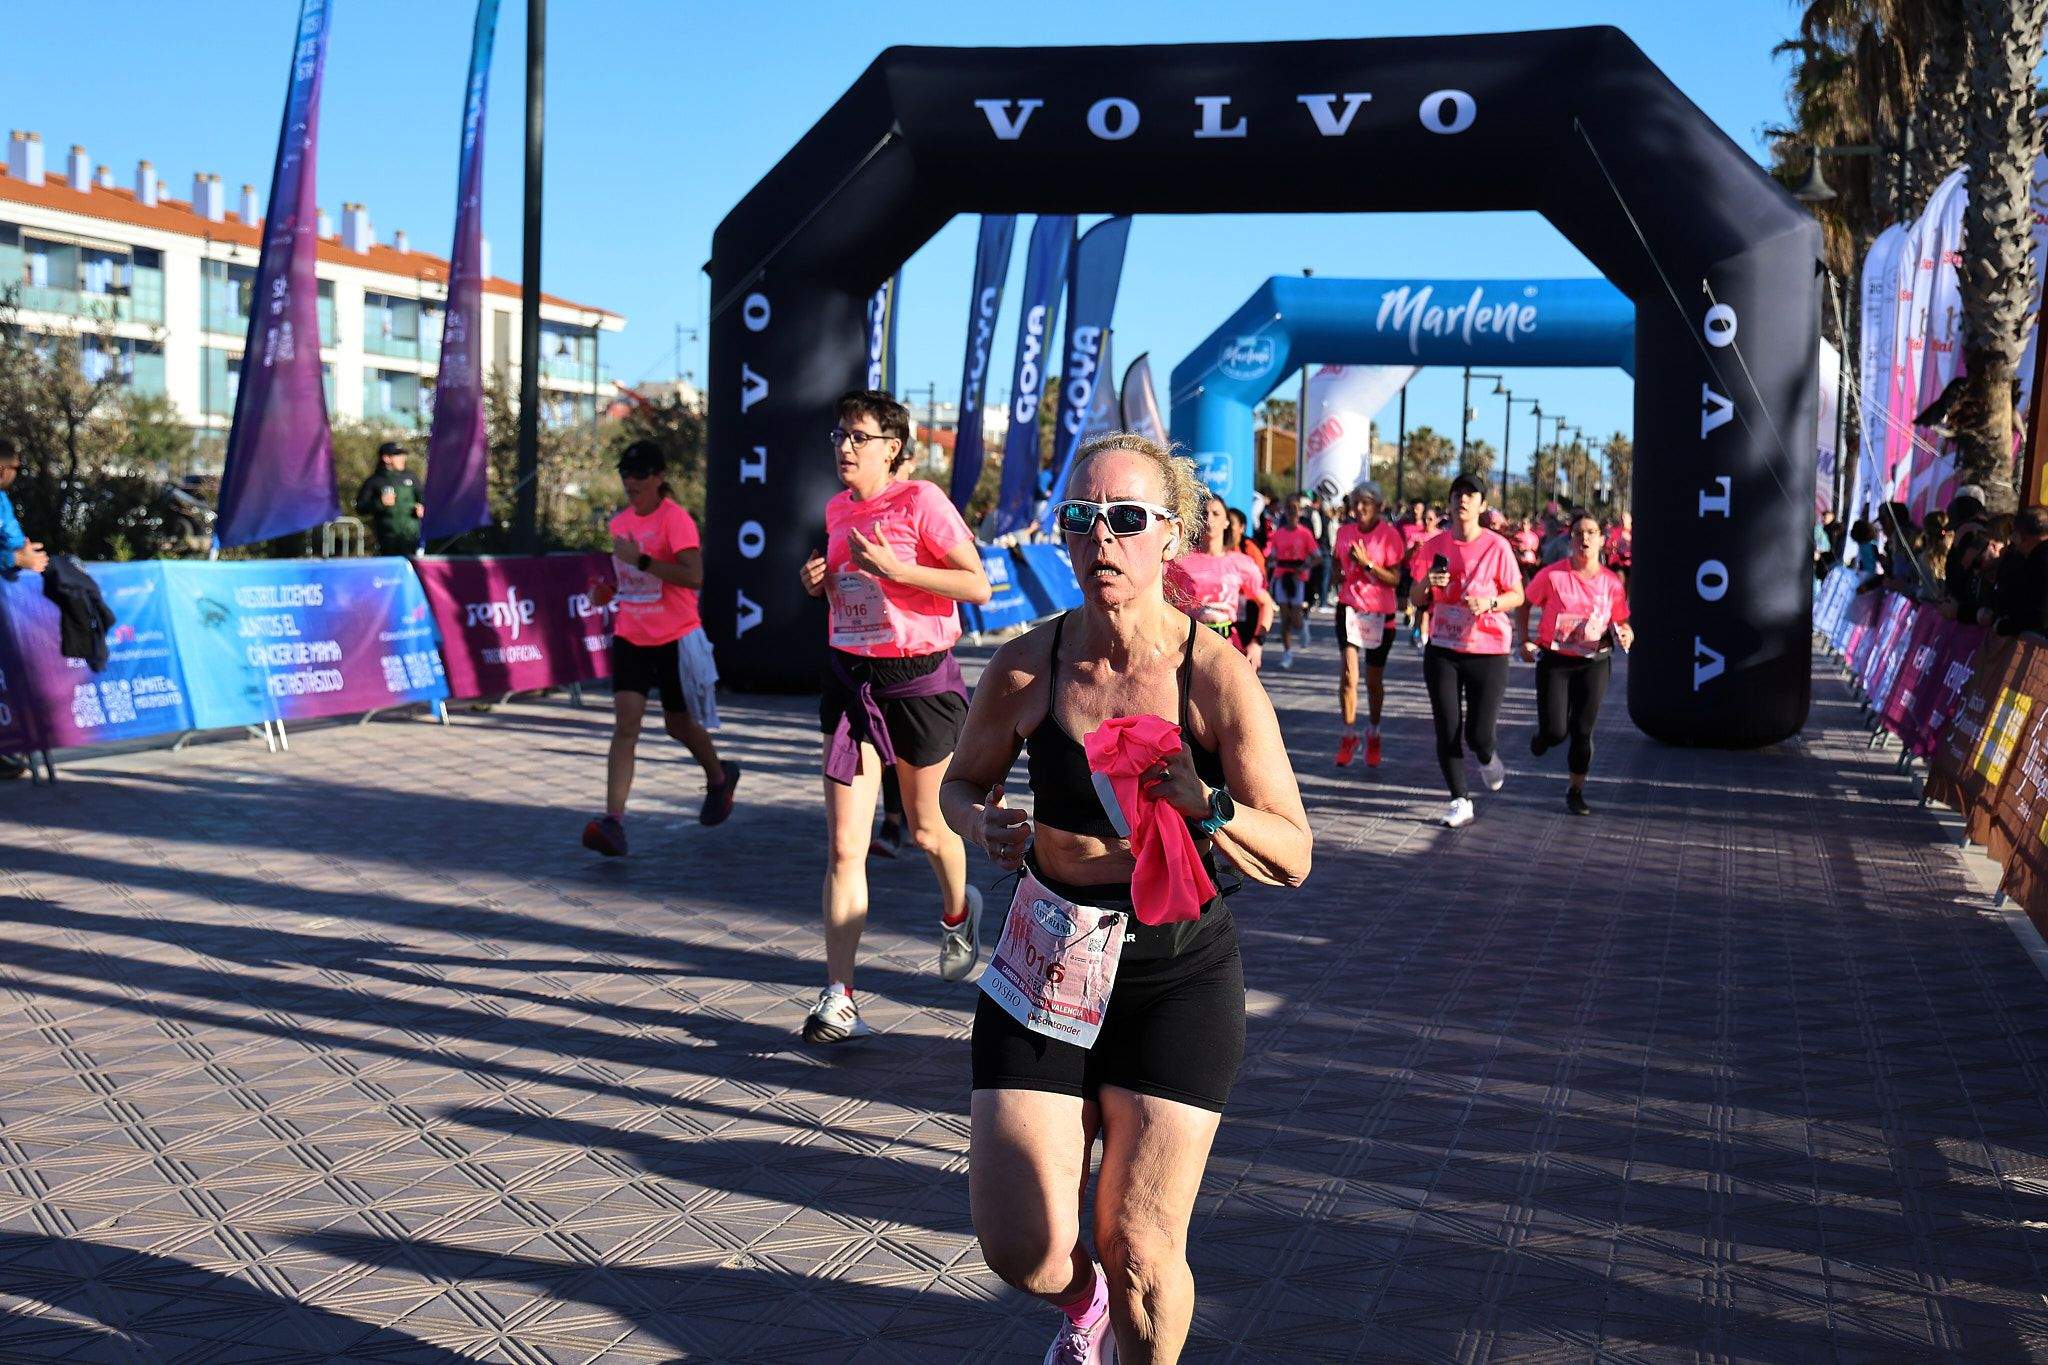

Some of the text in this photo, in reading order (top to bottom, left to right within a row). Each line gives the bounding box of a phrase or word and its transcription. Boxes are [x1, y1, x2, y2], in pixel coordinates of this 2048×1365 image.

[974, 89, 1477, 140] VOLVO
[1376, 285, 1537, 356] Marlene
[1016, 305, 1046, 424] GOYA
[736, 293, 771, 639] VOLVO
[1694, 303, 1738, 691] VOLVO
[465, 585, 535, 640] renfe
[845, 603, 867, 617] 016
[1026, 945, 1065, 983] 016
[991, 977, 1020, 1007] OYSHO
[1051, 1003, 1084, 1018] VALENCIA
[1036, 1015, 1081, 1036] Santander
